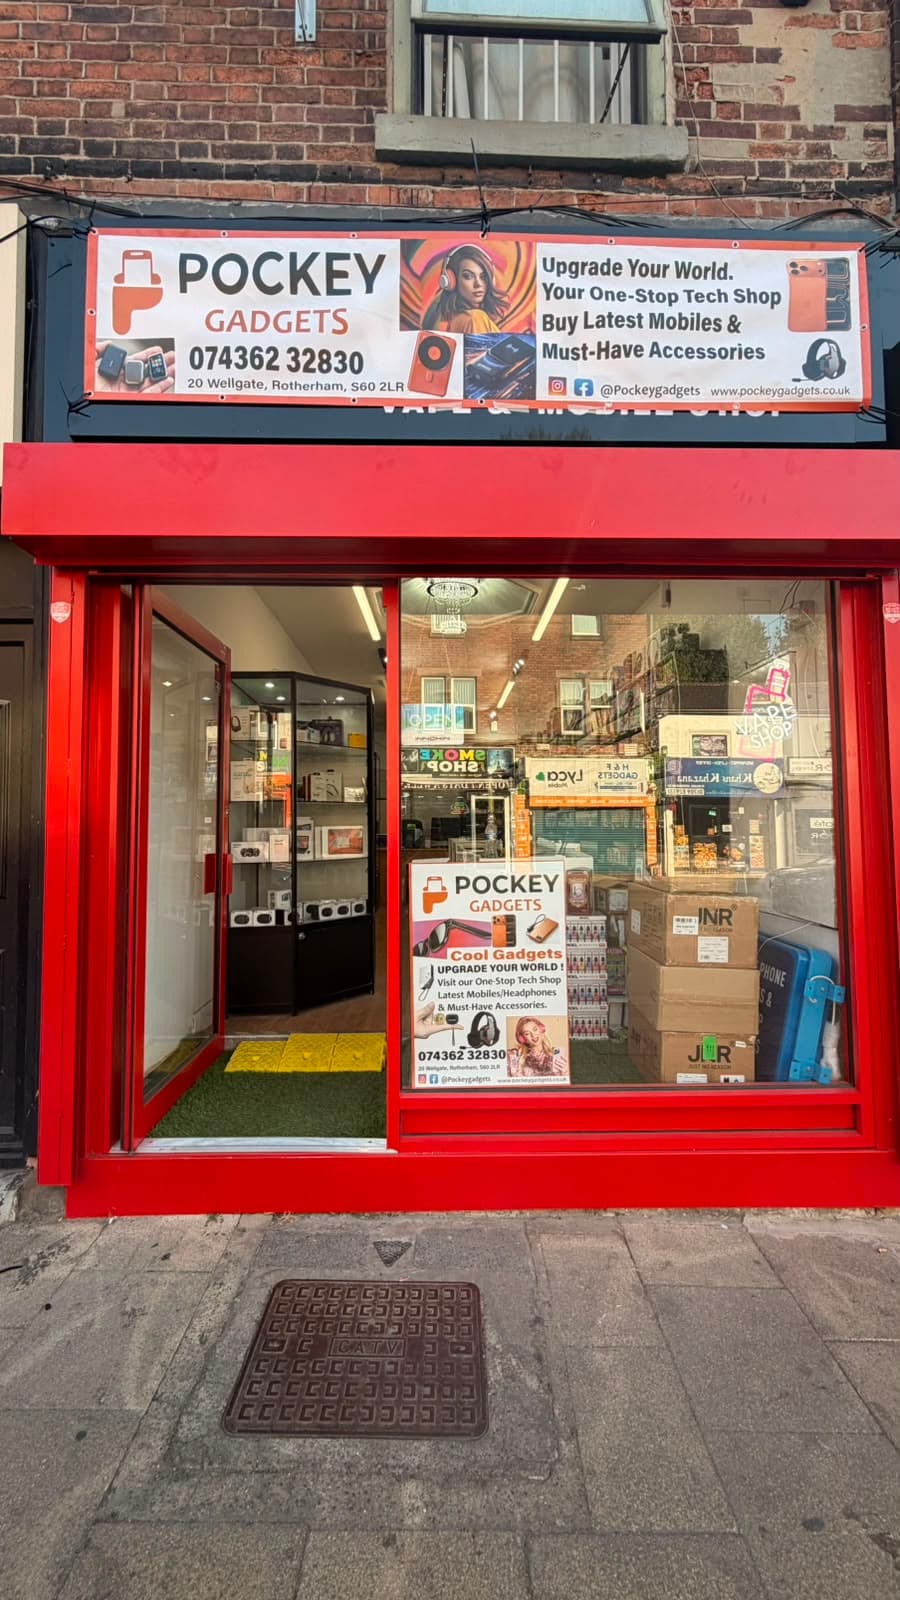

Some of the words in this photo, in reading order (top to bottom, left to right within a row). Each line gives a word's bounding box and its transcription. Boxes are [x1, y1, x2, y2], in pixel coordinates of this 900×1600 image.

[178, 251, 387, 296] POCKEY
[542, 257, 623, 279] Upgrade
[627, 258, 671, 279] Your
[673, 260, 734, 281] World.
[542, 283, 585, 301] Your
[589, 287, 680, 307] One-Stop
[683, 288, 731, 304] Tech
[734, 287, 782, 309] Shop
[205, 308, 349, 336] GADGETS
[542, 313, 579, 336] Buy
[583, 311, 644, 330] Latest
[649, 312, 722, 333] Mobiles
[726, 314, 742, 333] &
[542, 340, 645, 361] Must-Have
[648, 341, 765, 360] Accessories
[188, 345, 280, 372] 074362
[286, 346, 365, 376] 32830
[187, 378, 204, 389] 20
[207, 377, 267, 392] Wellgate,
[272, 379, 347, 393] Rotherham,
[351, 381, 376, 393] S60
[379, 382, 404, 393] 2LR
[600, 384, 701, 398] @Pockeygadgets
[711, 385, 851, 398] www.pockeygadgets.co.uk
[734, 703, 798, 735] VAPE
[750, 721, 792, 749] SHOP
[455, 874, 559, 894] POCKEY
[469, 899, 542, 912] GADGETS
[450, 949, 488, 961] Cool
[493, 948, 563, 962] Gadgets
[437, 964, 487, 974] UPGRADE
[490, 963, 518, 972] YOUR
[520, 963, 558, 972] WORLD
[560, 963, 564, 971] !
[760, 963, 787, 988] PHONE
[437, 978, 456, 987] Visit
[475, 976, 515, 987] One-Stop
[518, 976, 537, 984] Tech
[539, 975, 562, 985] Shop
[438, 991, 464, 999] Latest
[467, 988, 557, 999] Mobiles/Headphones
[767, 992, 773, 1008] &
[447, 1003, 493, 1011] Must-Have
[495, 1001, 548, 1010] Accessories.
[418, 1051, 464, 1061] 074362
[467, 1050, 506, 1060] 32830
[338, 1340, 399, 1354] CATV
